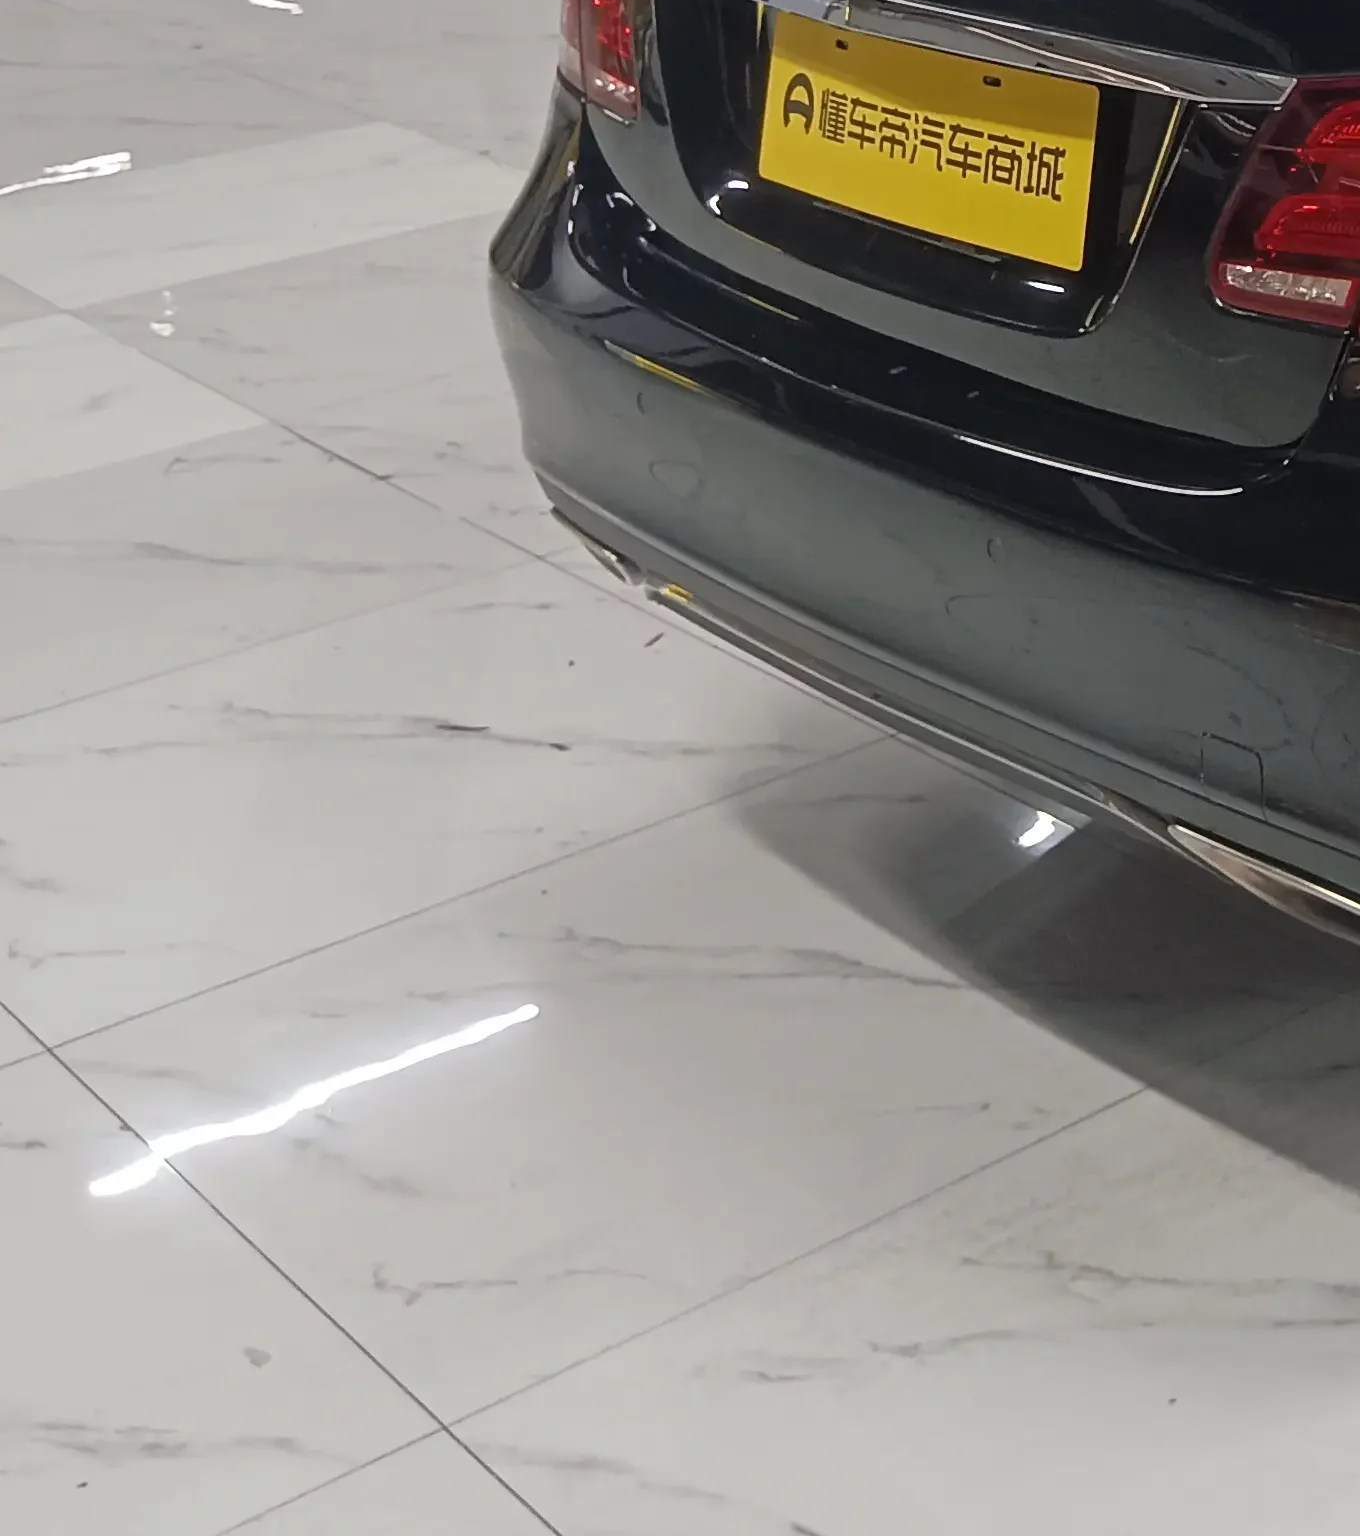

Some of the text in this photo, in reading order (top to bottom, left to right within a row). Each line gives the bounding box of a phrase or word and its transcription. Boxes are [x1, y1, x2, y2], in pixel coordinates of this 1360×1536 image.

[818, 86, 1067, 203] 懂车帝汽车商城
